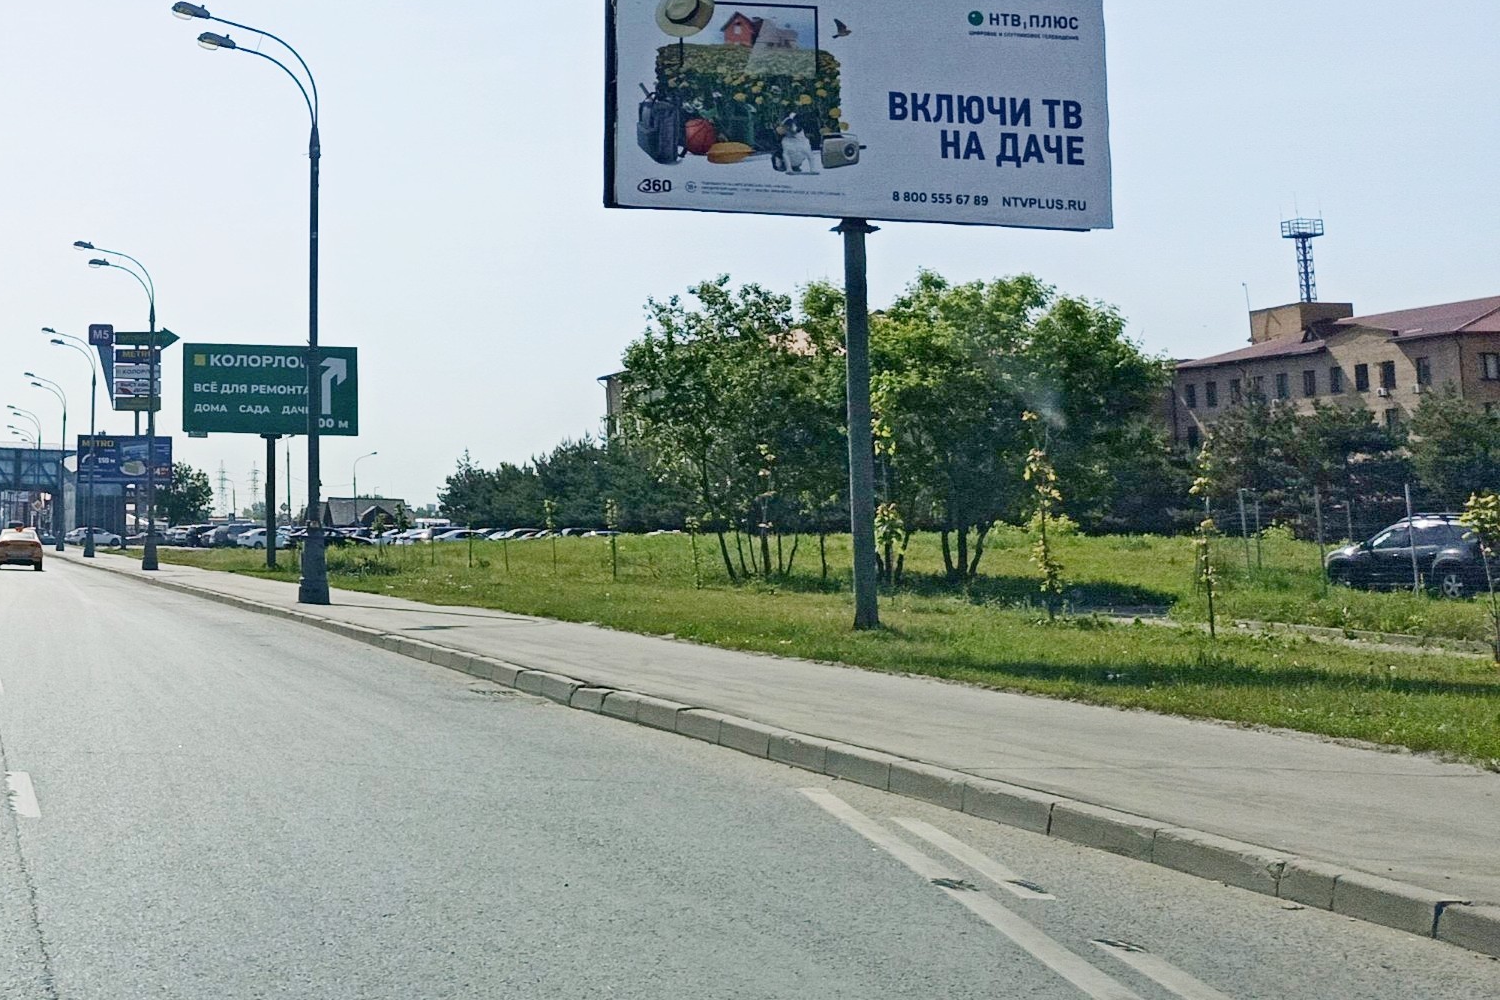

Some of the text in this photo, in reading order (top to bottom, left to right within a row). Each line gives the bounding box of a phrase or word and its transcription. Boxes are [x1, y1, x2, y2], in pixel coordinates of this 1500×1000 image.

[989, 13, 1079, 30] НТВ ПЛЮС
[888, 91, 1083, 129] ВКЛЮЧИ ТВ
[940, 130, 1085, 168] НА ДАЧЕ
[642, 179, 672, 192] 360
[892, 191, 988, 206] 8 800 555 67 89
[1002, 197, 1087, 211] NTVPLUS.RU
[122, 350, 150, 358] METR
[193, 381, 217, 393] ВСЁ
[220, 384, 247, 395] ДЛЯ
[193, 403, 228, 413] ДОМА
[239, 404, 270, 414] САДА
